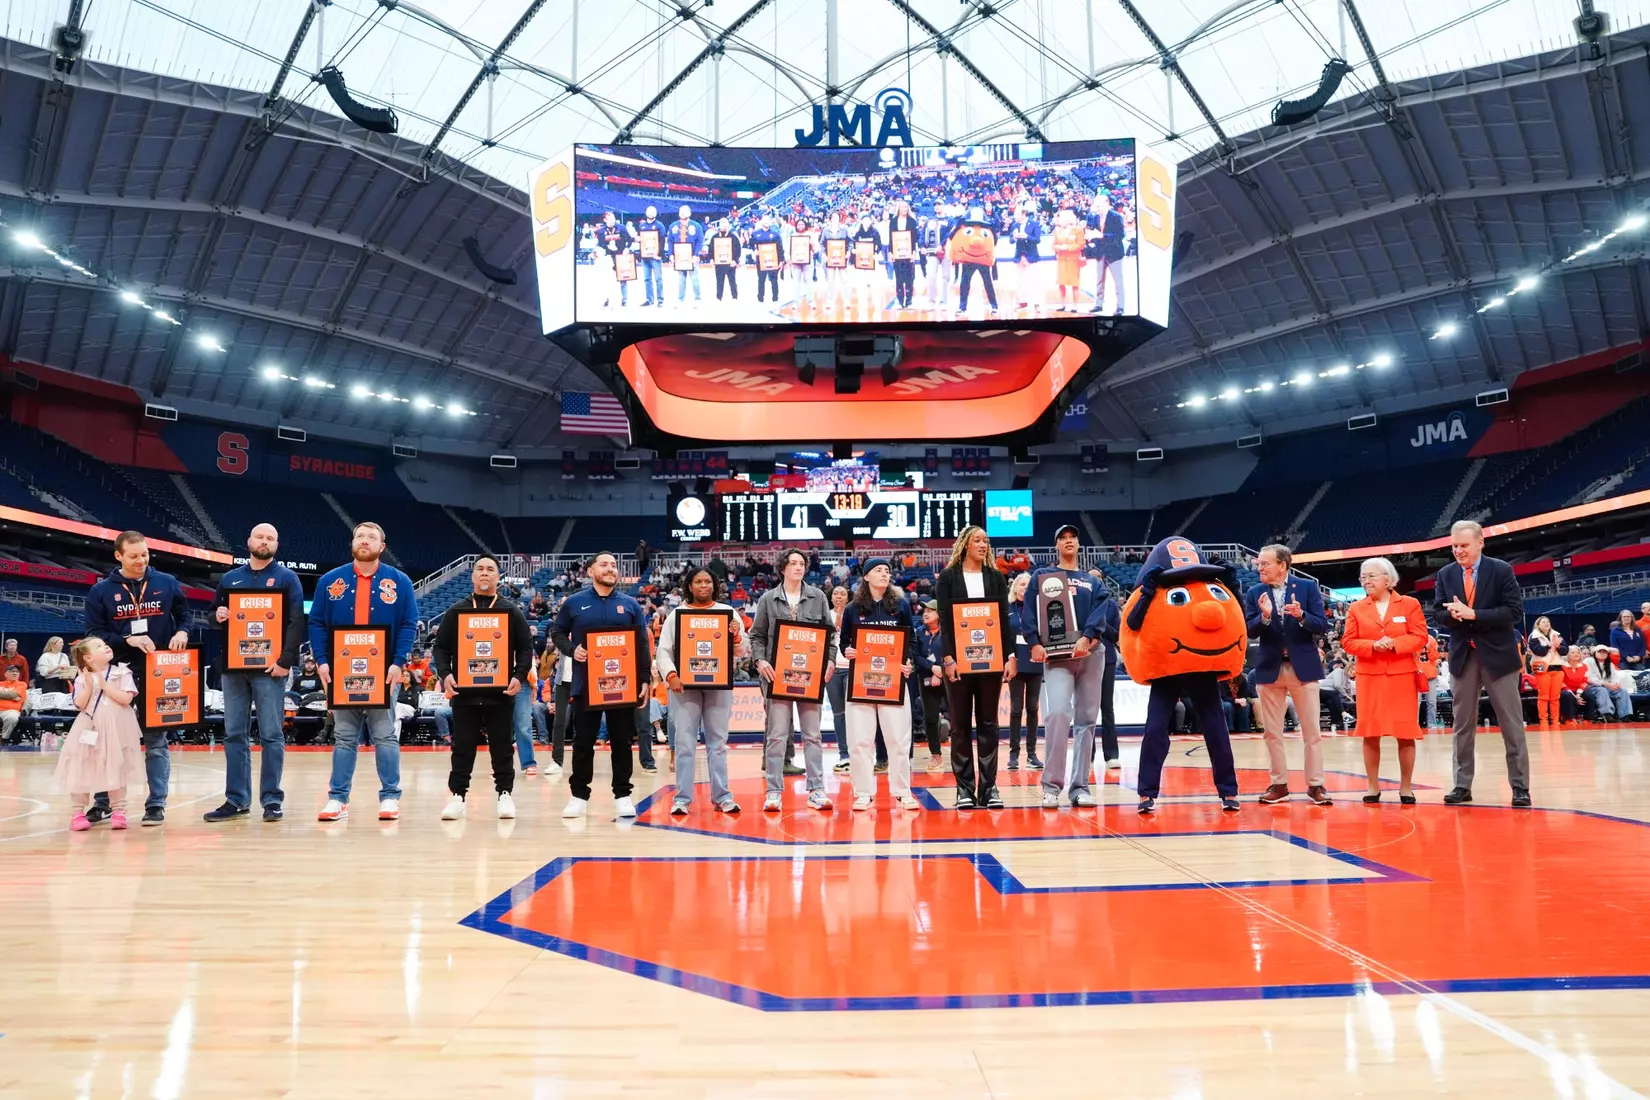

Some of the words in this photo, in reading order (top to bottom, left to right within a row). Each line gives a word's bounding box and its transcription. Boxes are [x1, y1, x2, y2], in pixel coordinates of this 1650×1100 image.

[795, 104, 914, 147] JMA
[685, 368, 793, 396] JMA
[893, 363, 999, 396] JMA
[1410, 418, 1468, 447] JMA
[217, 431, 249, 475] S
[290, 454, 374, 480] SYRACUSE
[834, 494, 863, 510] 13:19
[790, 505, 808, 529] 41
[887, 504, 908, 527] 30
[687, 528, 711, 537] WEBB
[299, 562, 317, 570] RUTH
